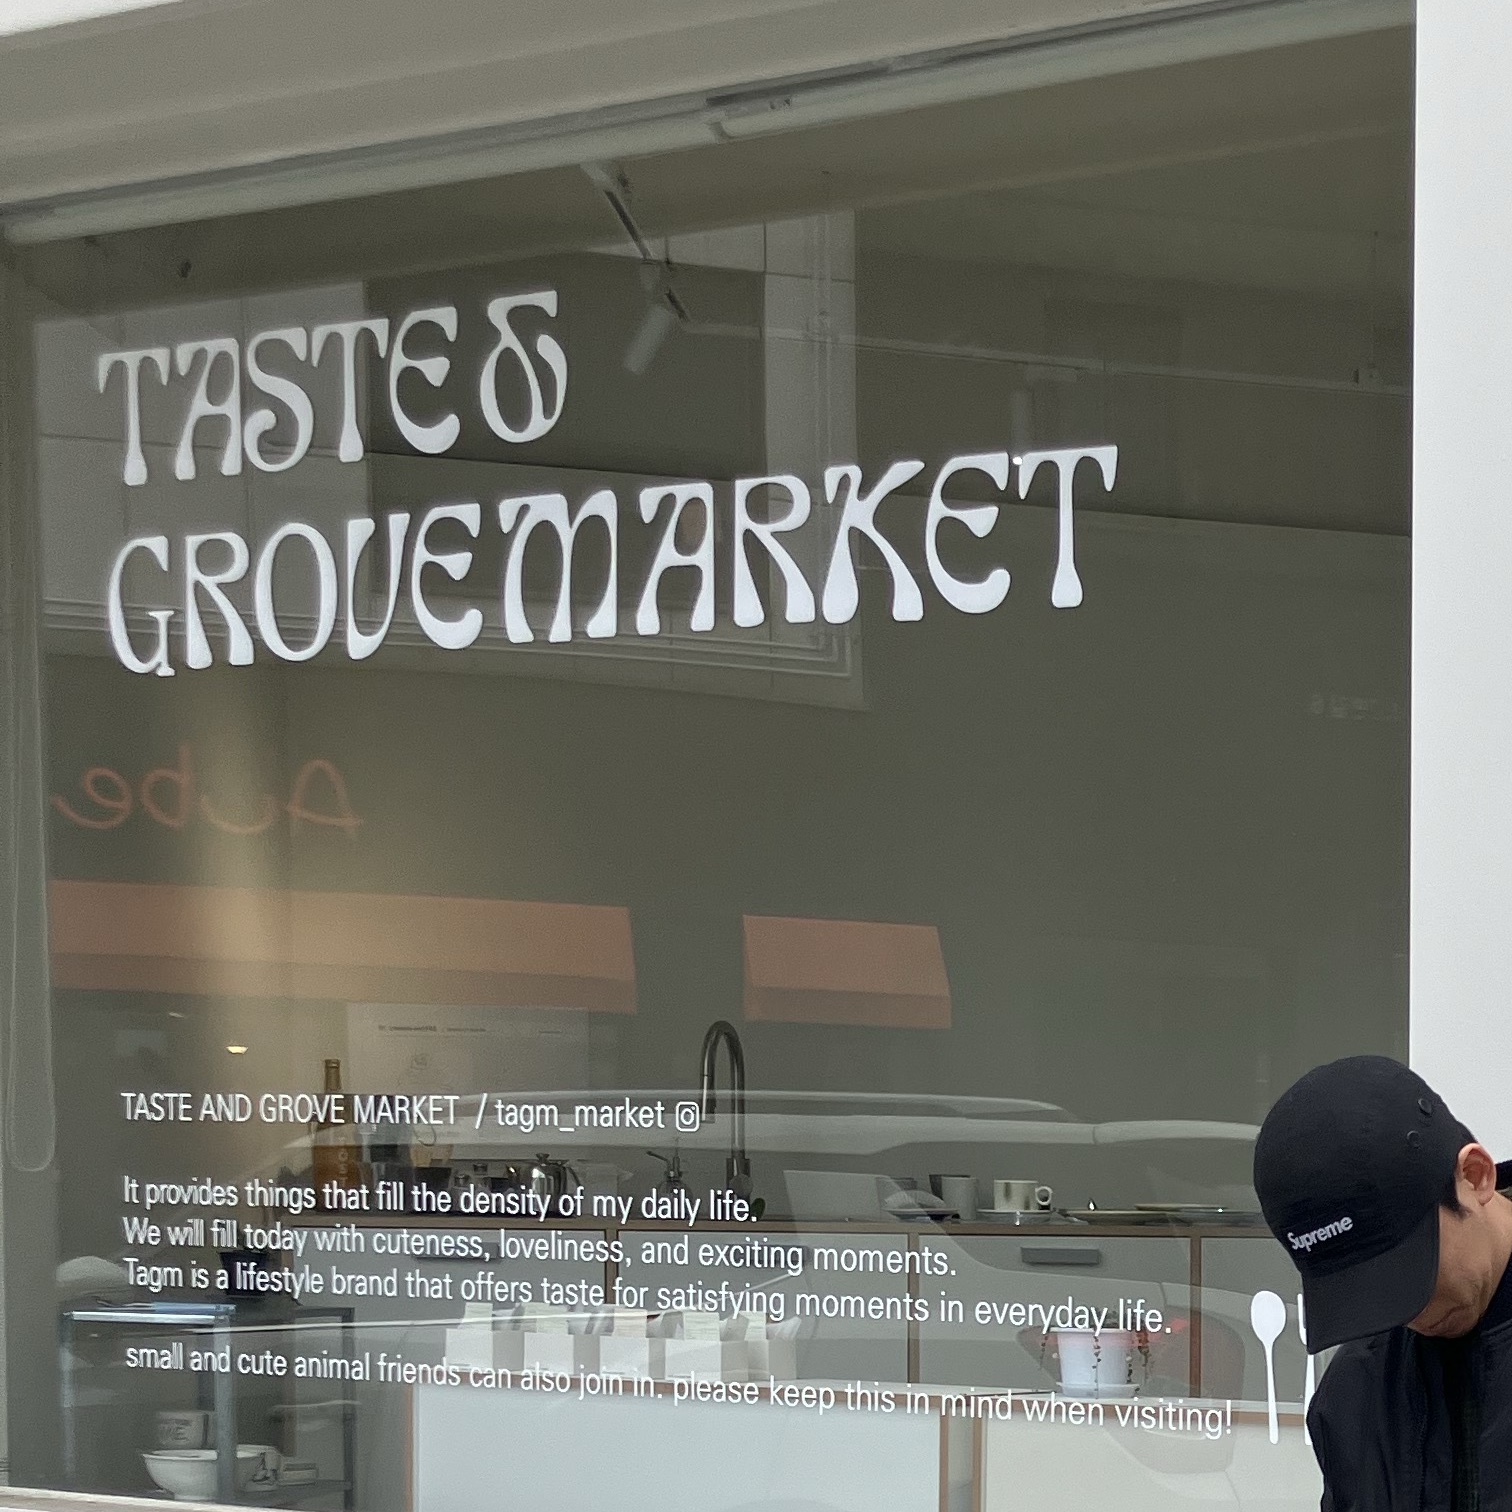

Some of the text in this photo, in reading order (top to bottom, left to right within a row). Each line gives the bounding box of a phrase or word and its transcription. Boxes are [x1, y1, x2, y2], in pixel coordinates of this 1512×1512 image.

[99, 289, 569, 487] TASTE &
[120, 1092, 665, 1133] TASTE AND GROVE MARKET / tagm_market
[123, 1175, 757, 1226] It provides things that fill the density of my daily life.
[122, 1216, 956, 1277] We will fill today with cuteness, loveliness, and exciting moments.
[1287, 1216, 1354, 1252] Supreme
[122, 1257, 1172, 1336] Tagm is a lifestyle brand that offers taste for satisfying moments in everyday life.
[125, 1342, 1232, 1440] small and cute animal friends can also join in. please keep this in mind when visiting!
